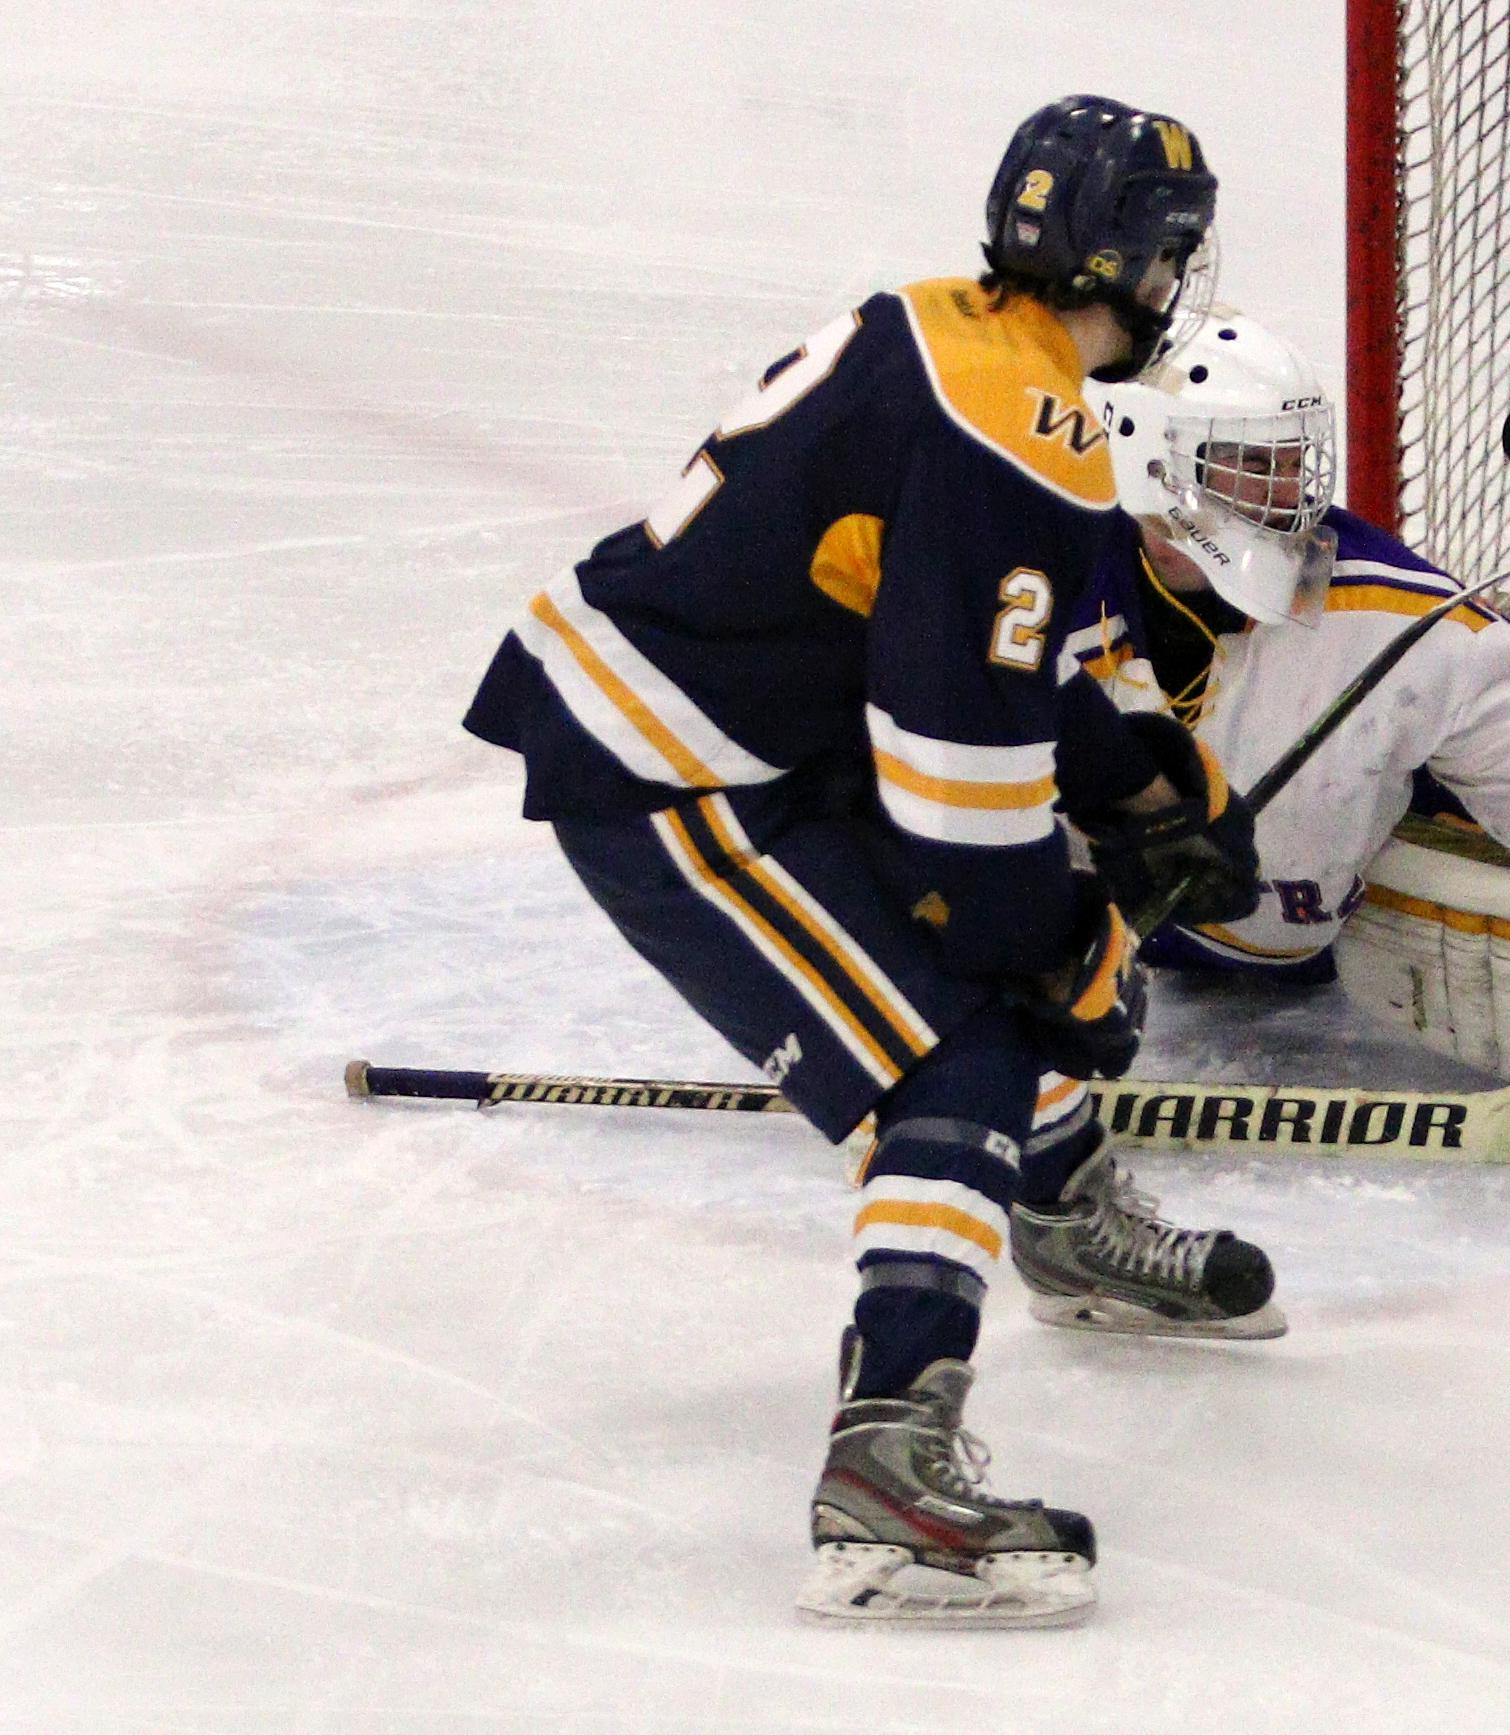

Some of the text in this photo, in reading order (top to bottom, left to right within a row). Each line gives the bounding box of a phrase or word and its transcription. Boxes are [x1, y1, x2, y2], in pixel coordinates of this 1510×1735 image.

[1016, 168, 1055, 213] 2
[1280, 394, 1323, 412] CCM
[989, 565, 1054, 672] 2
[1090, 1092, 1468, 1148] WARRIOR
